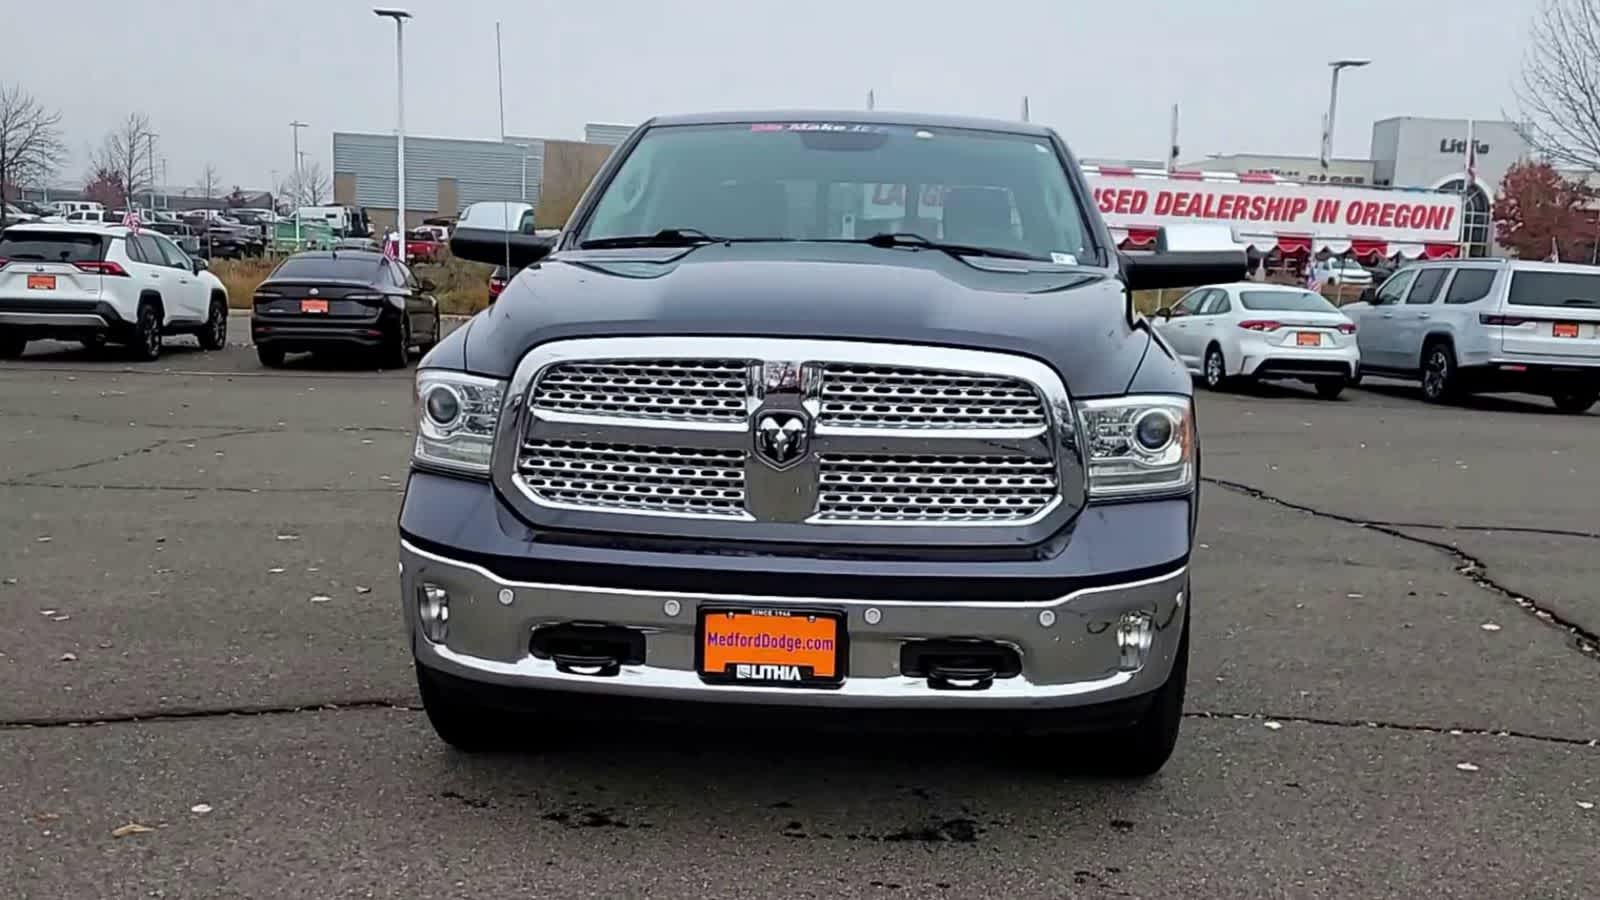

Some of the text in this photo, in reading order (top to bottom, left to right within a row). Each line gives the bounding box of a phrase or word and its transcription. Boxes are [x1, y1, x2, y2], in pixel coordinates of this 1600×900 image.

[1094, 188, 1455, 230] SED DEALERSHIP IN OREGON!
[707, 631, 834, 652] MedfordDodge.com
[751, 664, 802, 681] LITHIA
